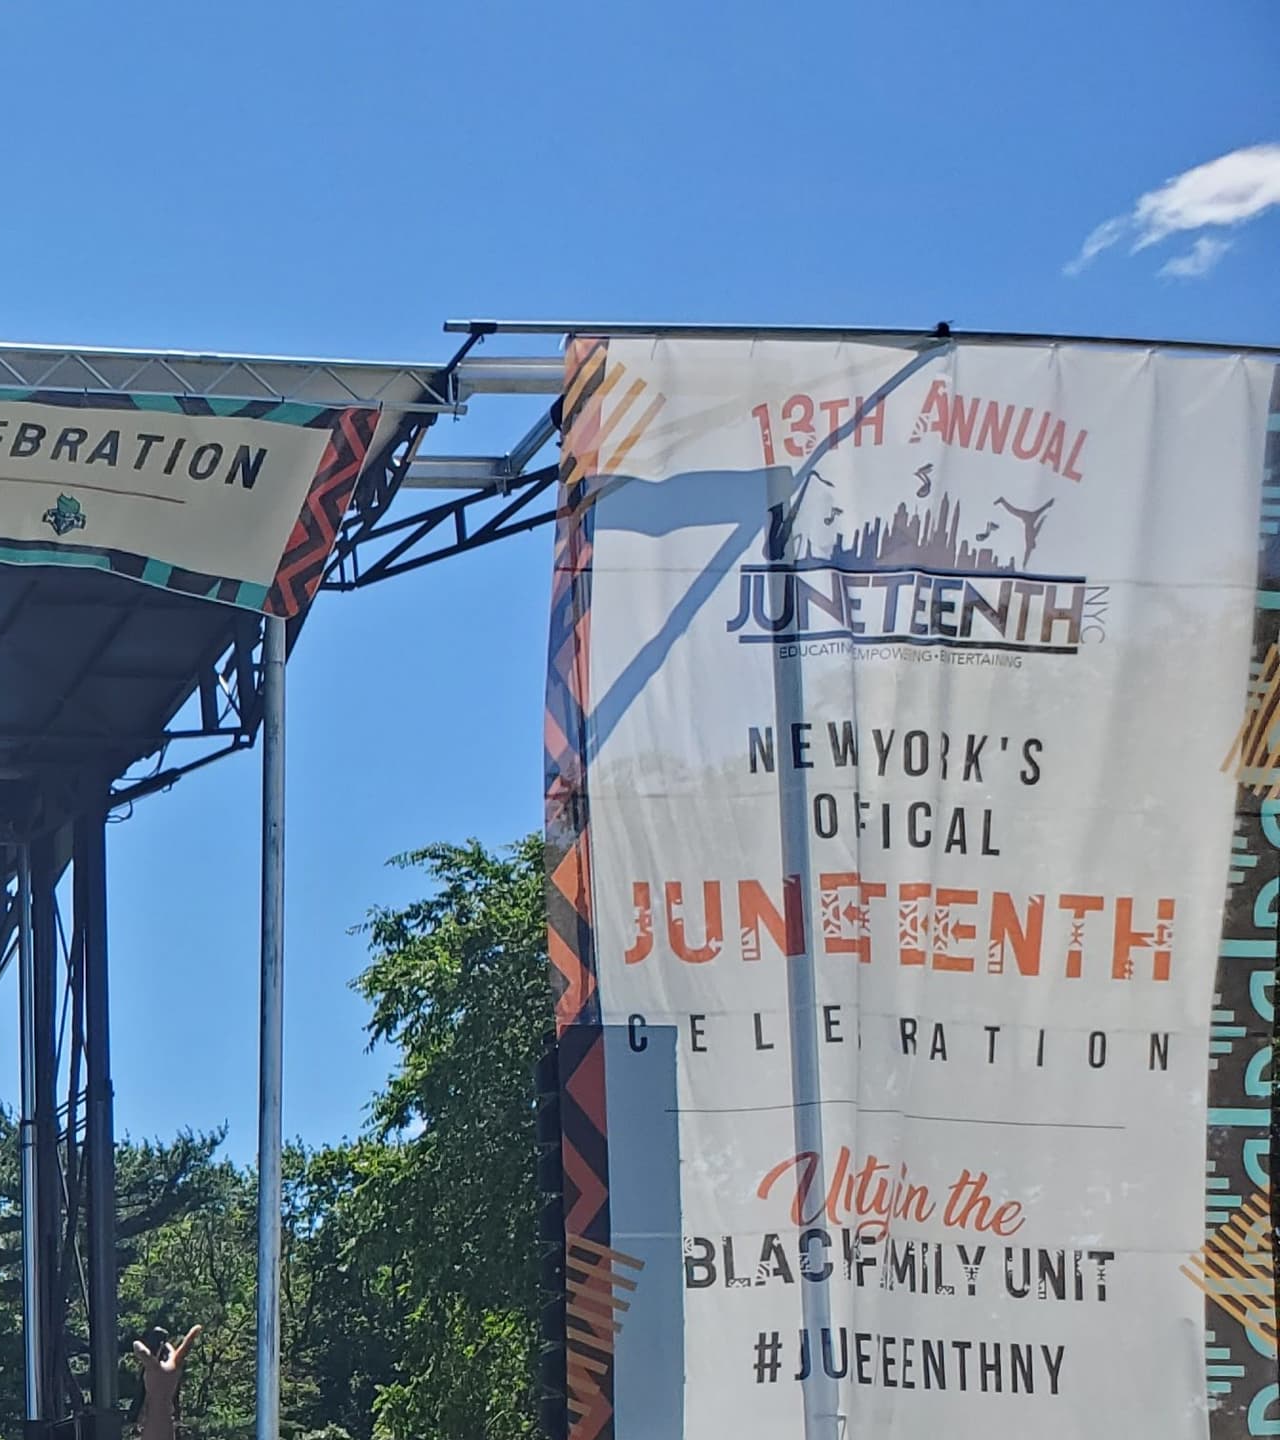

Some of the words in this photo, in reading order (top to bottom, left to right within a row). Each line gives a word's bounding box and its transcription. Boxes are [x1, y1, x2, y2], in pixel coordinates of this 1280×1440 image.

[752, 394, 885, 466] 13TH
[909, 380, 1088, 482] ANNUAL
[726, 570, 1085, 644] JUNETEENTH
[1083, 586, 1109, 644] NYC
[748, 721, 858, 773] NEW
[628, 1006, 1169, 1070] CELERATION
[943, 1168, 1027, 1237] the
[855, 1235, 986, 1297] FMILY
[1005, 1247, 1115, 1302] UNIT
